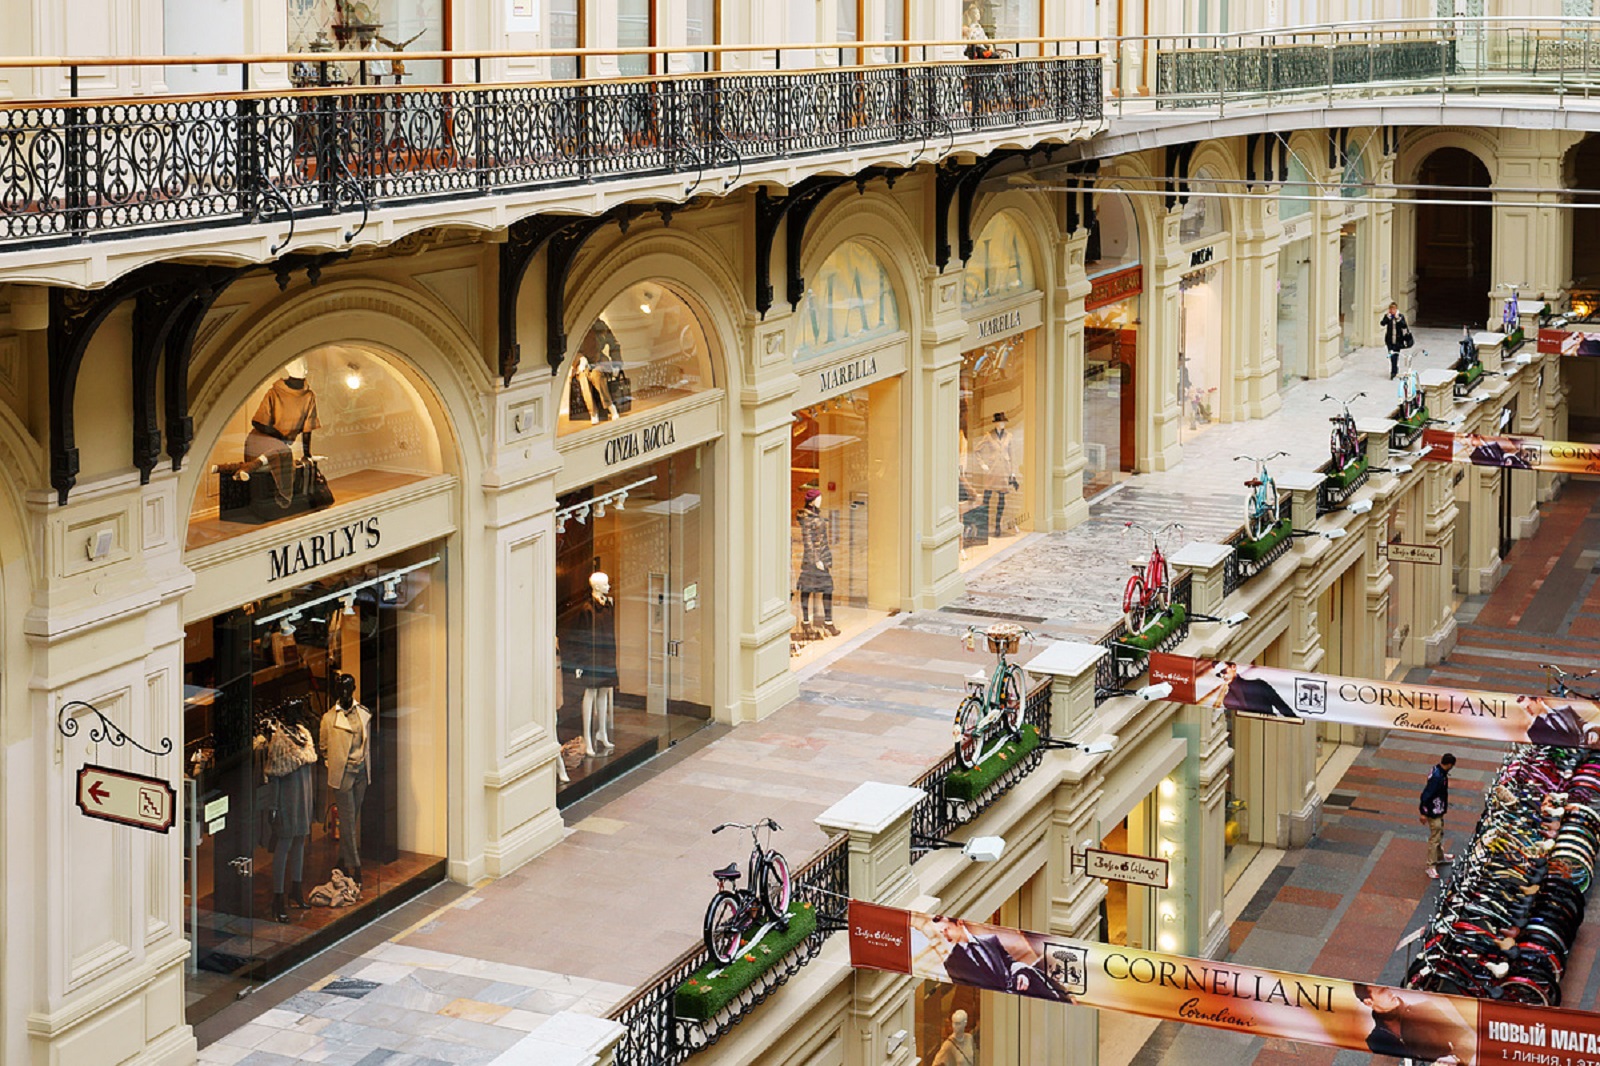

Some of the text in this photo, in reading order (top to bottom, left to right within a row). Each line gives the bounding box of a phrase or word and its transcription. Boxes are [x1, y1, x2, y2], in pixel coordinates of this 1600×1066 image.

[978, 310, 1021, 339] MARELLA
[820, 356, 877, 392] MARELLA
[605, 420, 675, 466] CINZIA ROCCA
[267, 516, 381, 582] MARLY'S
[1338, 683, 1508, 719] CORNELIANI
[1392, 712, 1449, 733] Corneliani
[1103, 953, 1335, 1014] CORNELIANI
[1178, 997, 1255, 1028] Corneliani
[1488, 1020, 1547, 1047] НОВЫЙ
[1502, 1048, 1508, 1059] 1
